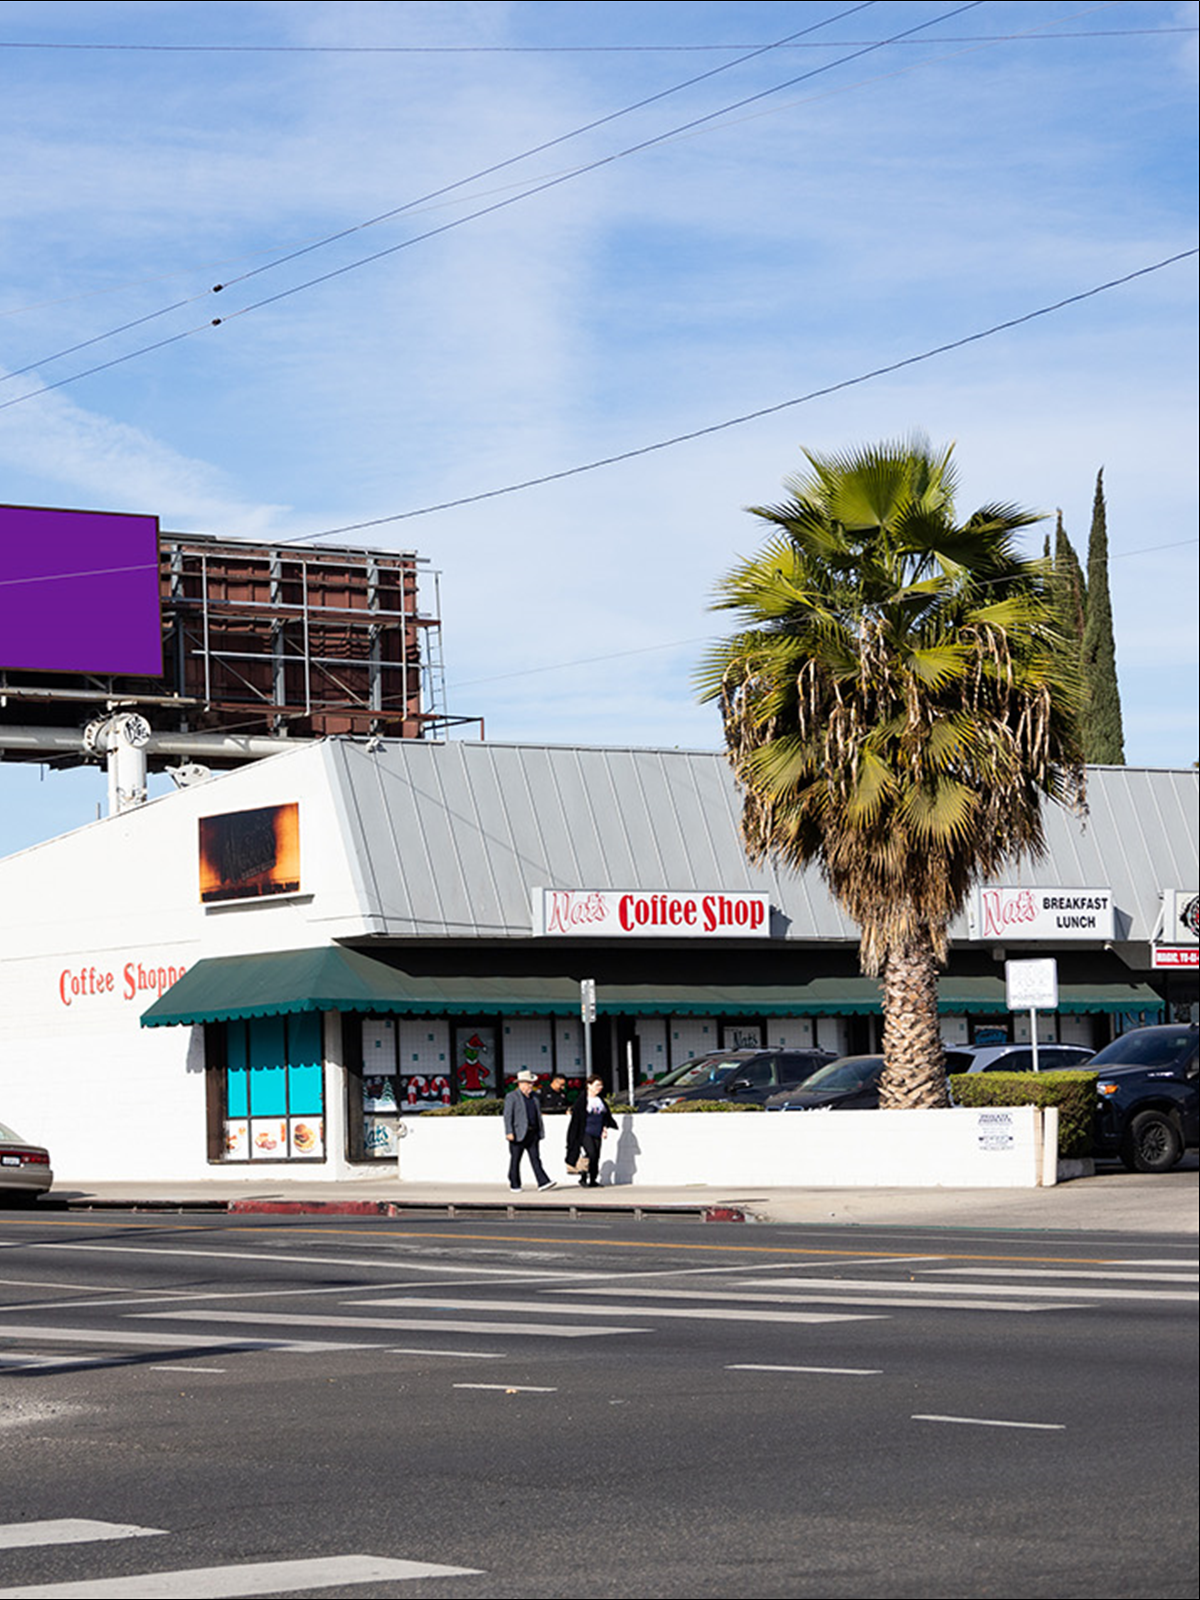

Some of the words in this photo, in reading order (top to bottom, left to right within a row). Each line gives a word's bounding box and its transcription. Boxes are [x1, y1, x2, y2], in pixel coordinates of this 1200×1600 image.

[618, 894, 697, 932] Coffee
[702, 895, 765, 932] Shop
[1043, 897, 1109, 910] BREAKFAST
[1056, 916, 1096, 928] LUNCH
[59, 968, 115, 1006] Coffee
